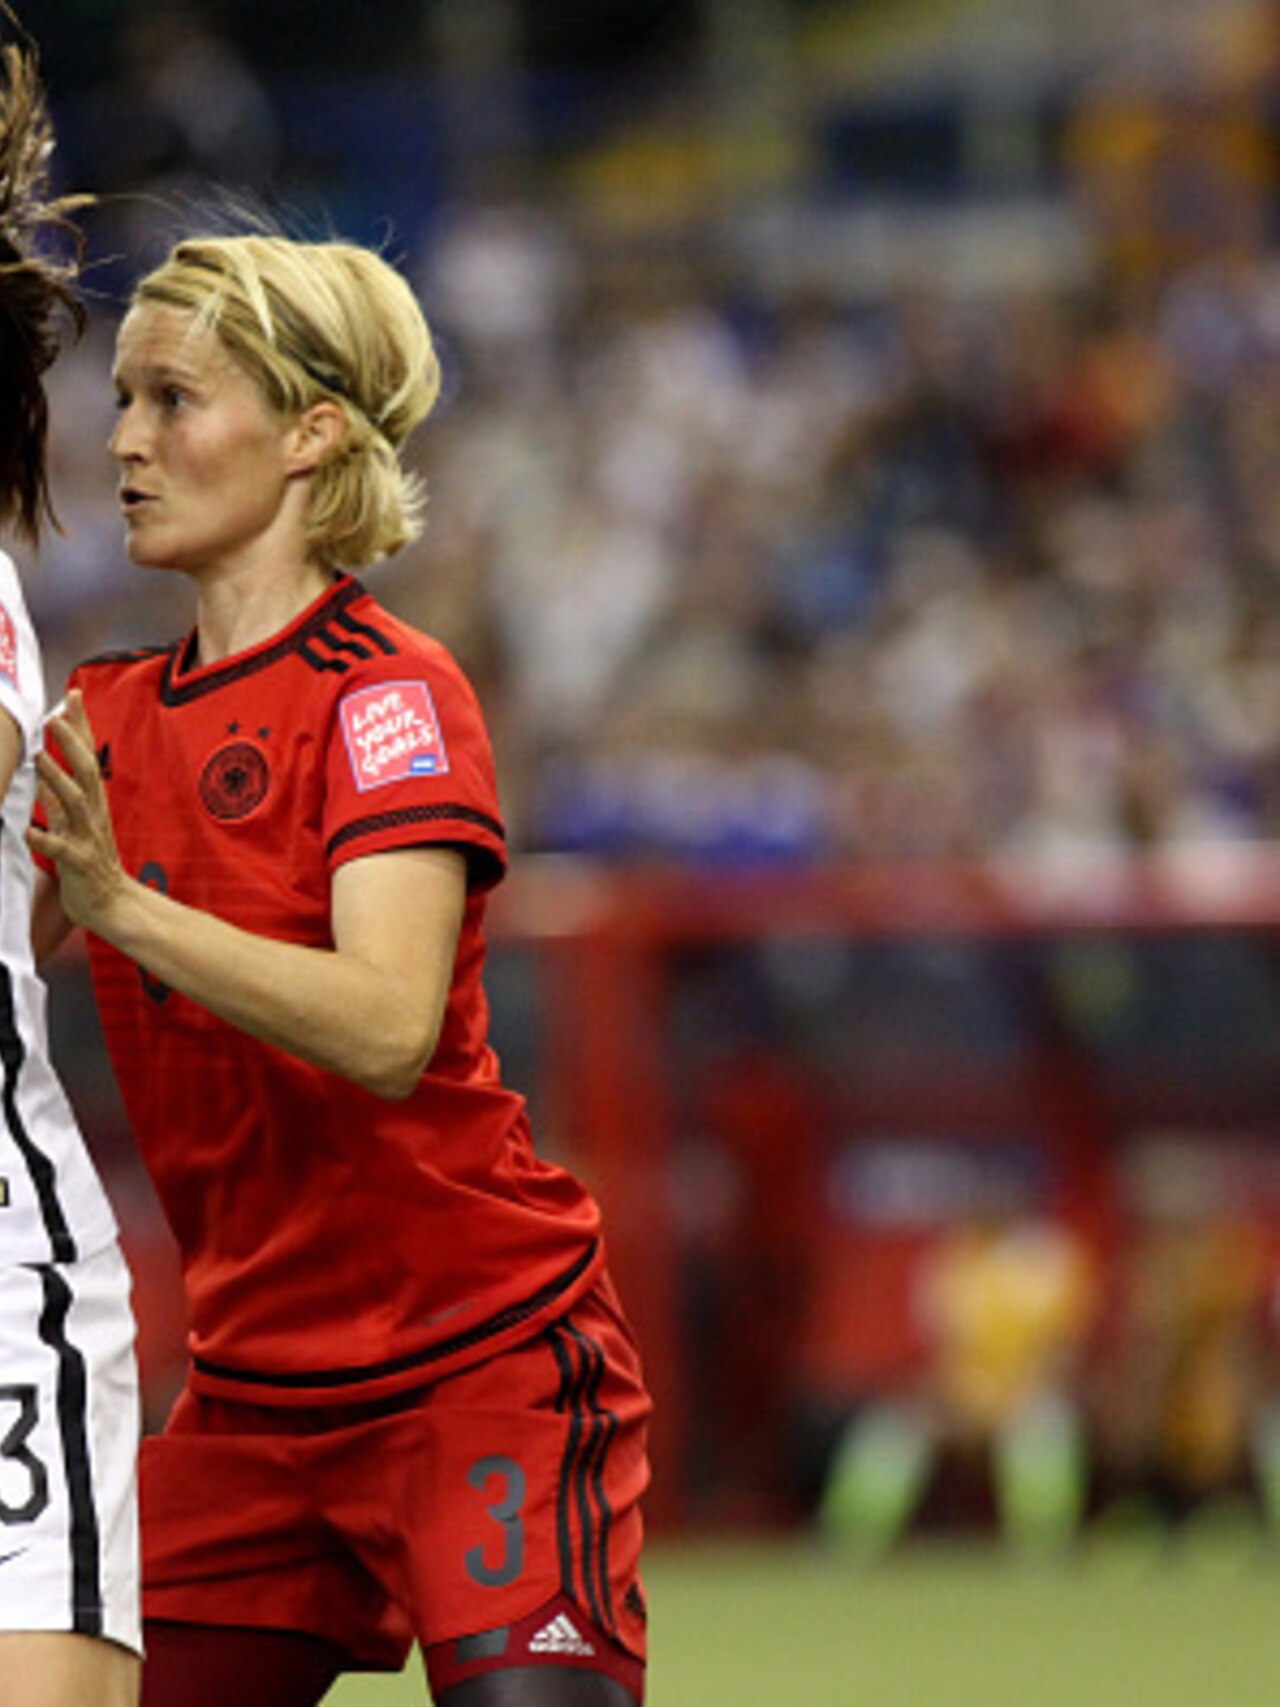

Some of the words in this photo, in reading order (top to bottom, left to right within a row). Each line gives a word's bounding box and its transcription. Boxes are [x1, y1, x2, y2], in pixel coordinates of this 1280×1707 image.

[352, 691, 406, 732] LIVE
[355, 710, 424, 752] YOUR
[361, 725, 433, 776] GOALS
[465, 1453, 526, 1587] 3
